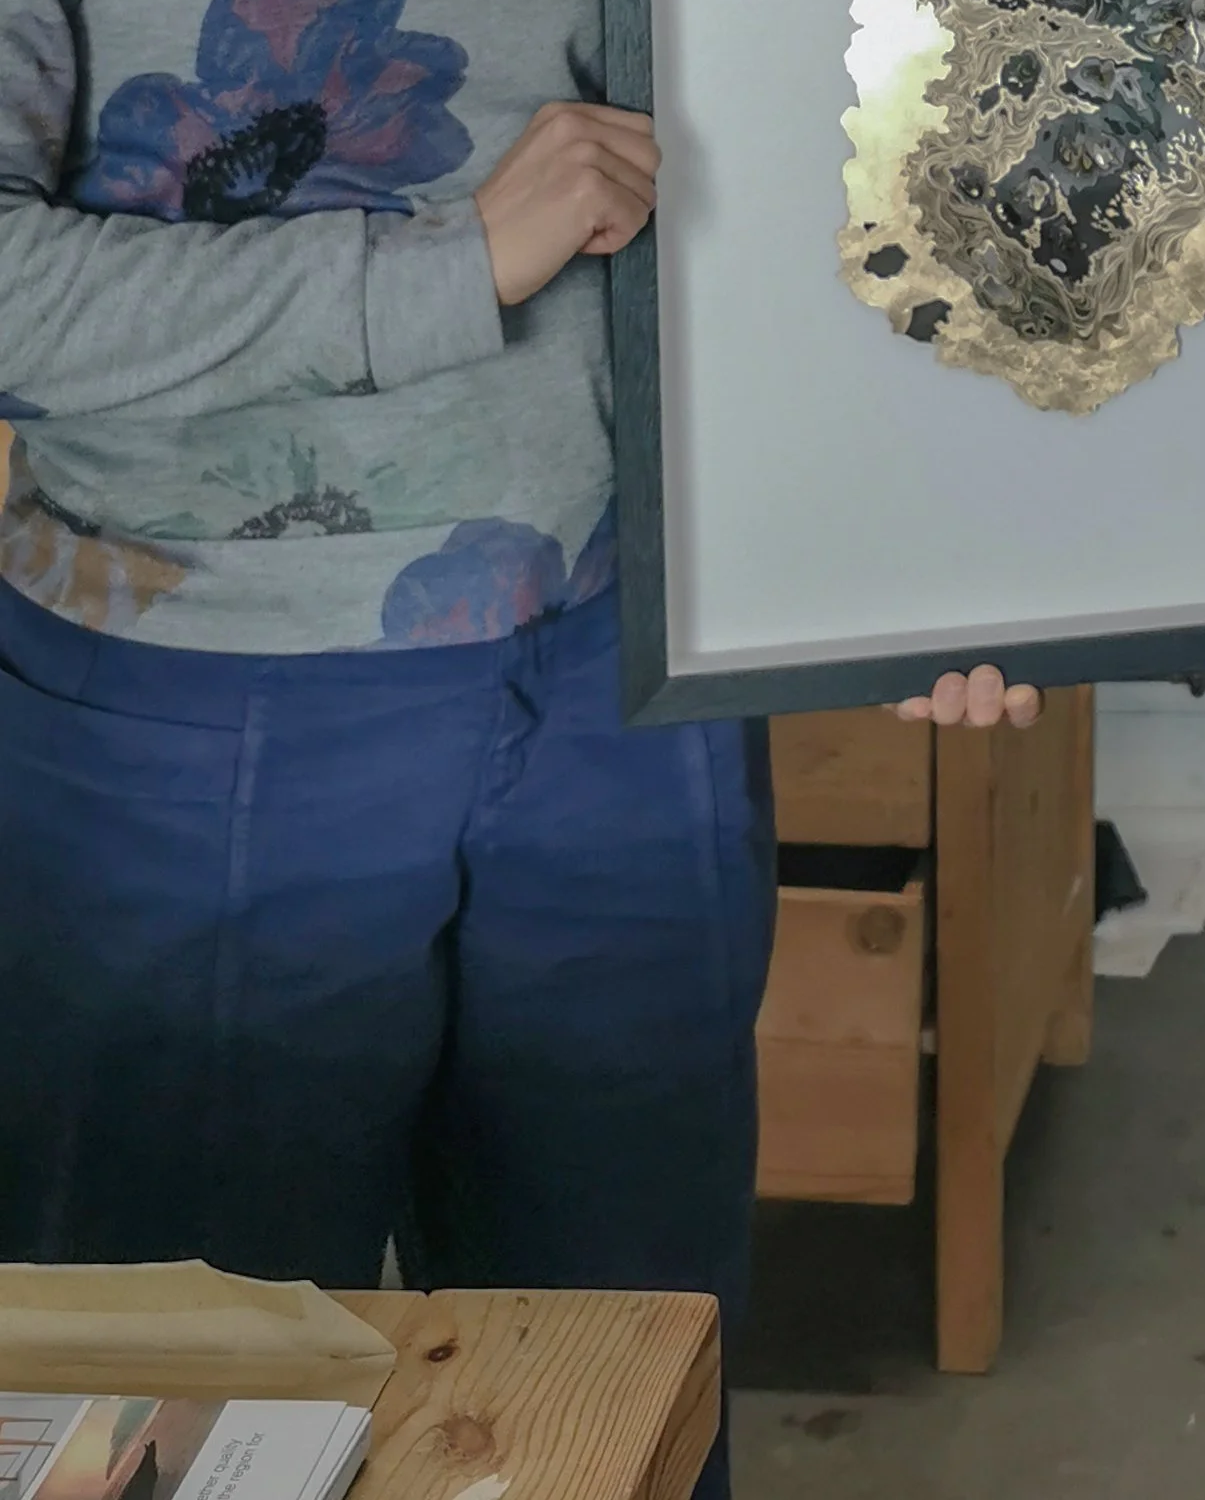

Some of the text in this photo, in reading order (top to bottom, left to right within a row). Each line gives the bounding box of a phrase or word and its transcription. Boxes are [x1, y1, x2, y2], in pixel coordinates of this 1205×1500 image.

[213, 1438, 243, 1473] quality
[229, 1448, 257, 1481] region
[245, 1432, 265, 1446] for
